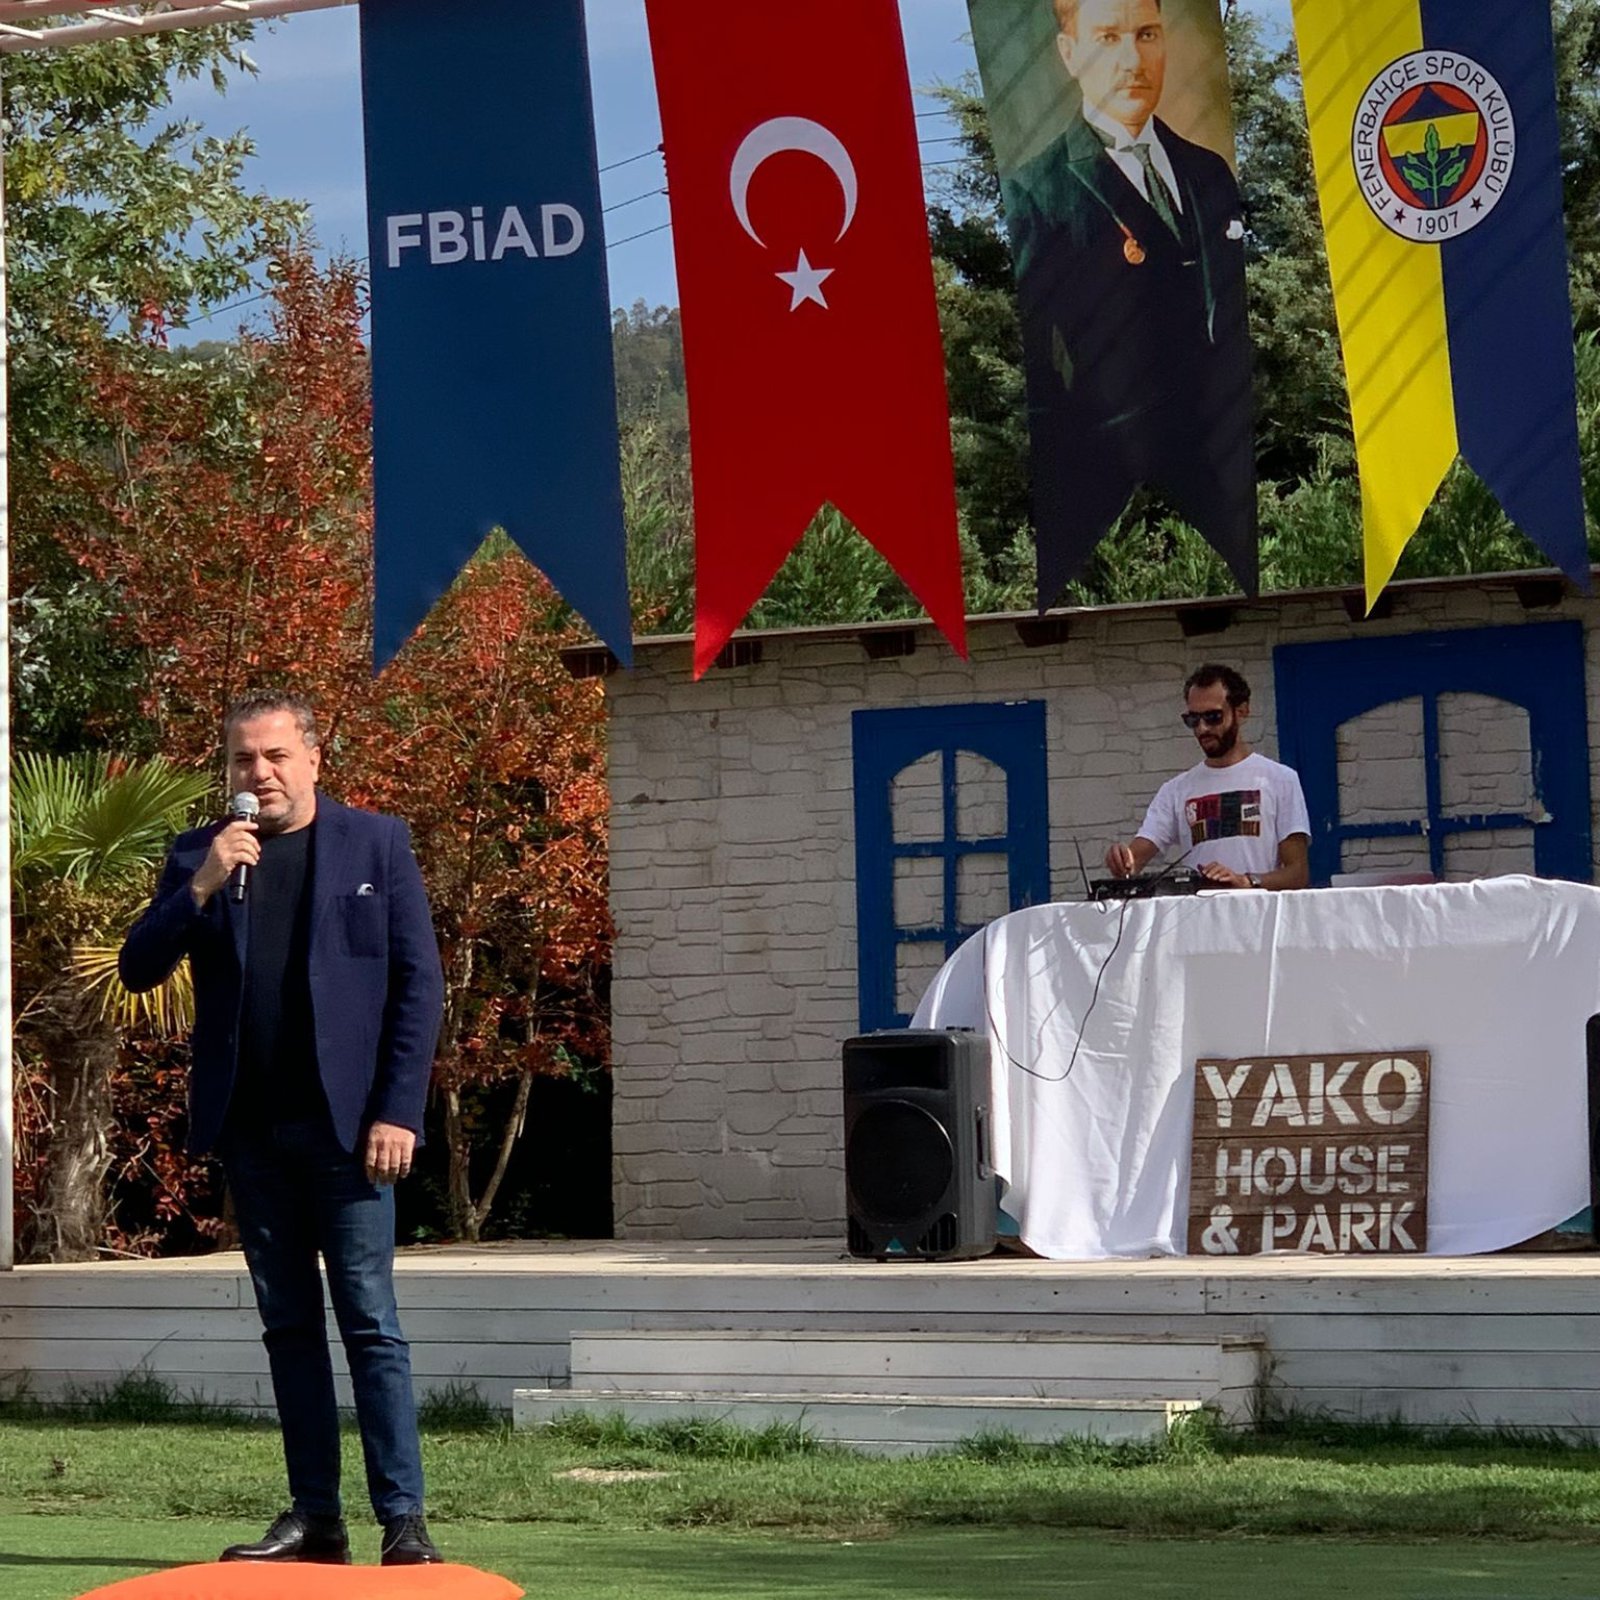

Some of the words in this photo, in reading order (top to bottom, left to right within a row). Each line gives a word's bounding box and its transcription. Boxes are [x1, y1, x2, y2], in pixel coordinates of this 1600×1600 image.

[1357, 60, 1420, 211] FENERBAHÇE
[1425, 56, 1486, 94] SPOR
[1482, 89, 1513, 194] KULÜBÜ
[1416, 211, 1459, 235] 1907
[1200, 1058, 1424, 1128] YAKO
[1214, 1145, 1411, 1196] HOUSE
[1201, 1203, 1240, 1254] &
[1261, 1202, 1418, 1251] PARK
